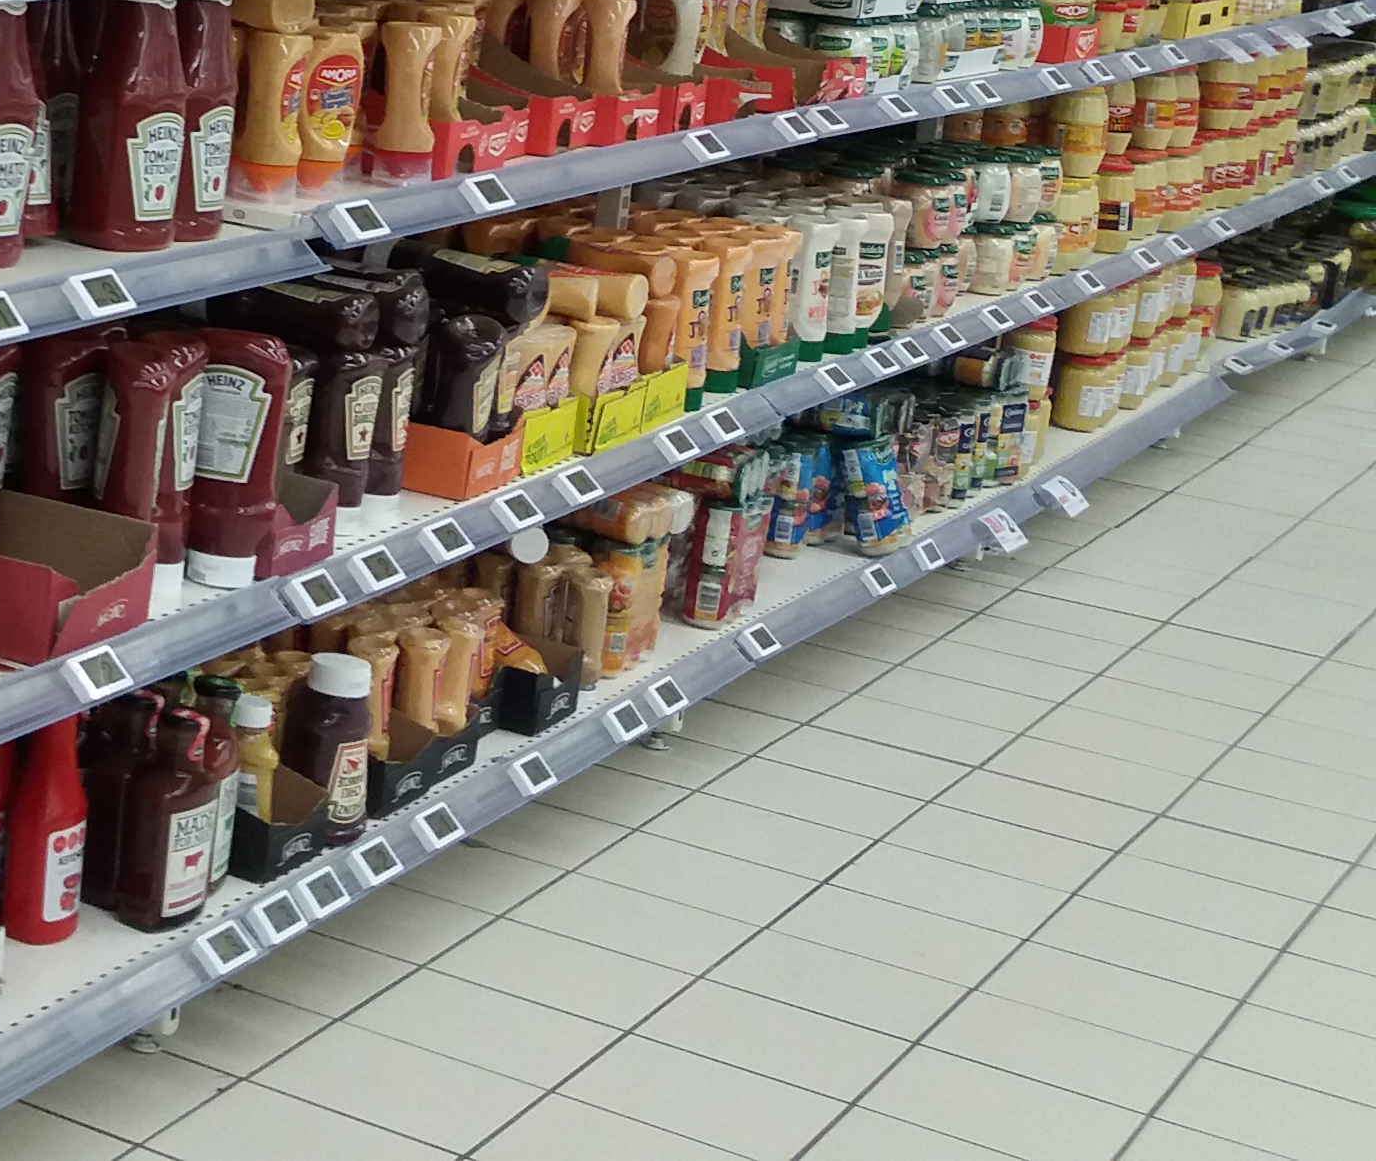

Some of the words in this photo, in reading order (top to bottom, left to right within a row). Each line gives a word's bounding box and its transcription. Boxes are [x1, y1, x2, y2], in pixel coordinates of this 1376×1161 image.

[321, 67, 357, 82] AMORA
[149, 126, 179, 141] HEINZ
[143, 150, 179, 164] TOMATO
[206, 374, 246, 392] HEINZ
